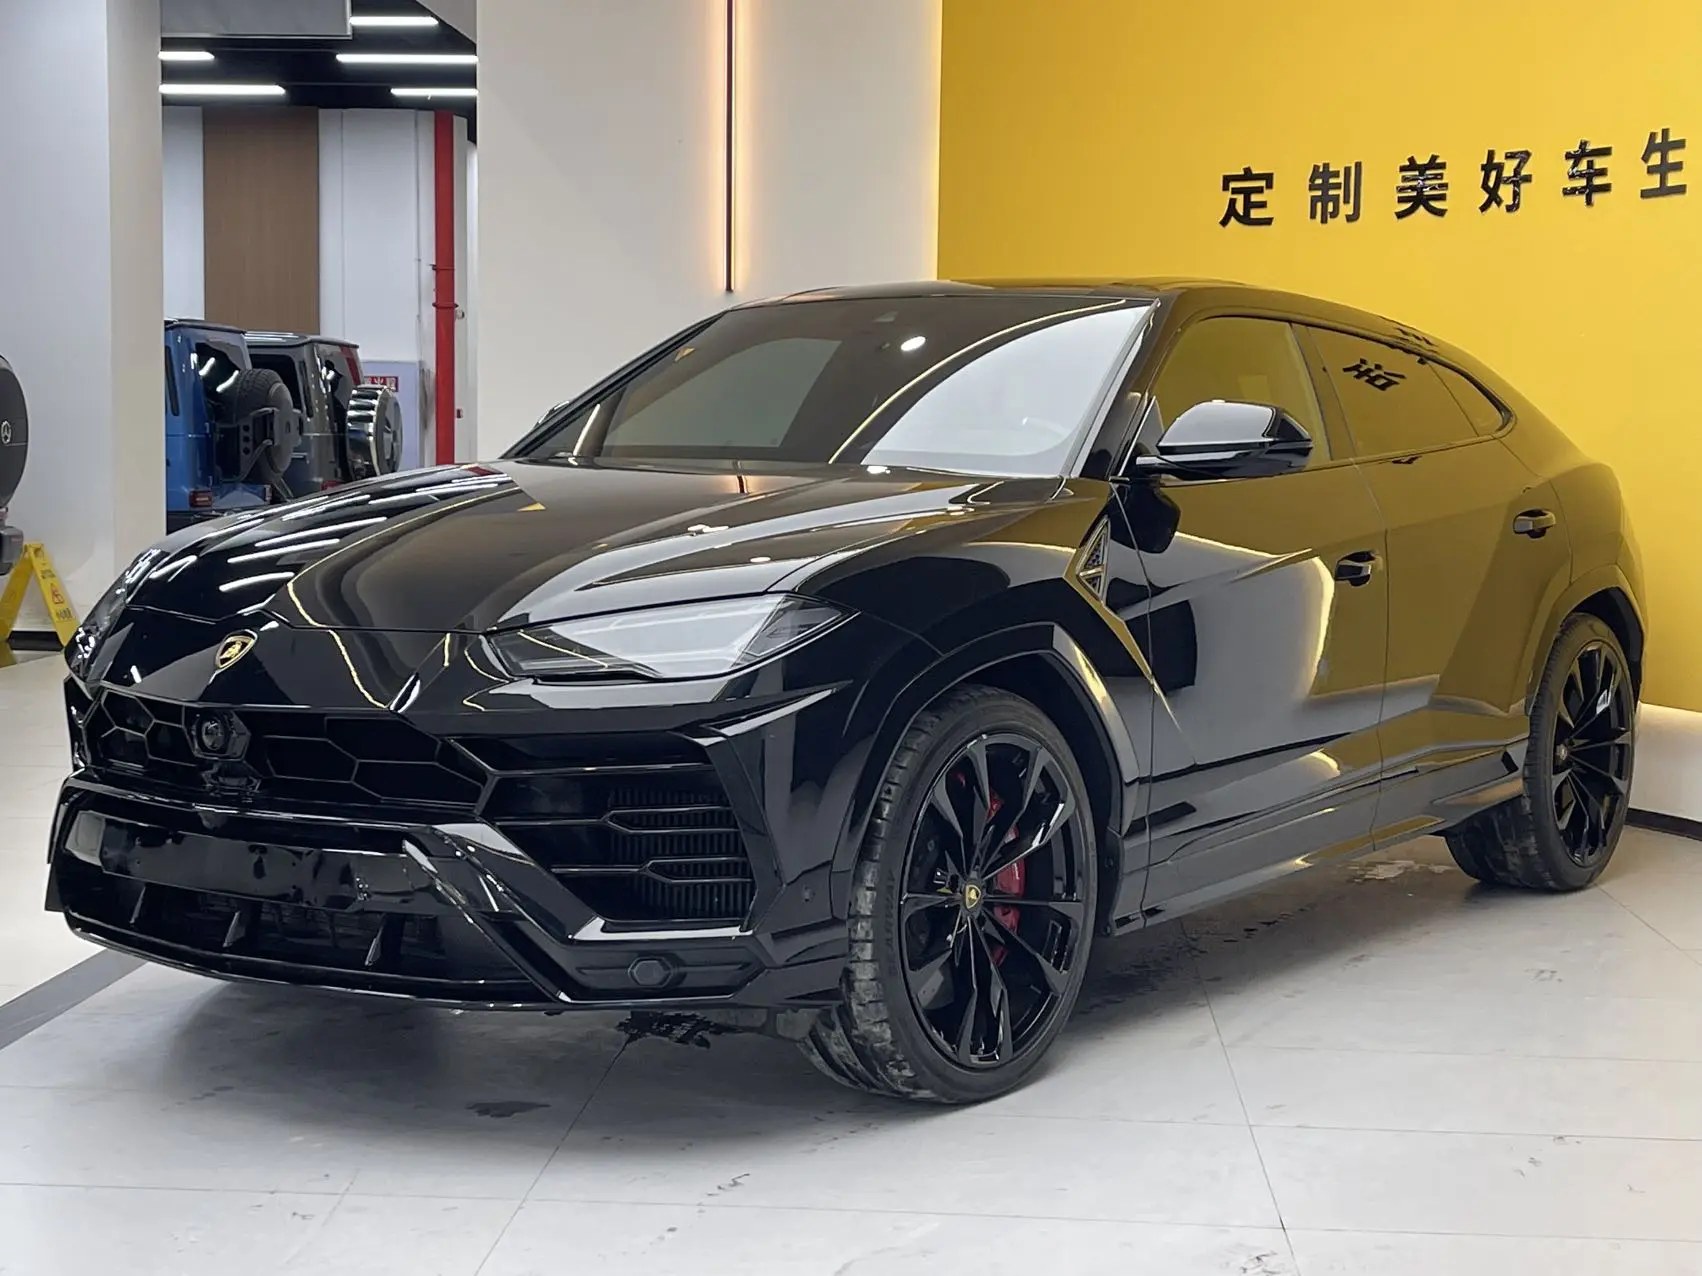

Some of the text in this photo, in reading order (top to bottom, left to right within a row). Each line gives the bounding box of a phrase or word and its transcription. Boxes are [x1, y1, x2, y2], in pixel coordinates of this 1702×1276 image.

[1219, 127, 1687, 227] 定制美好车生
